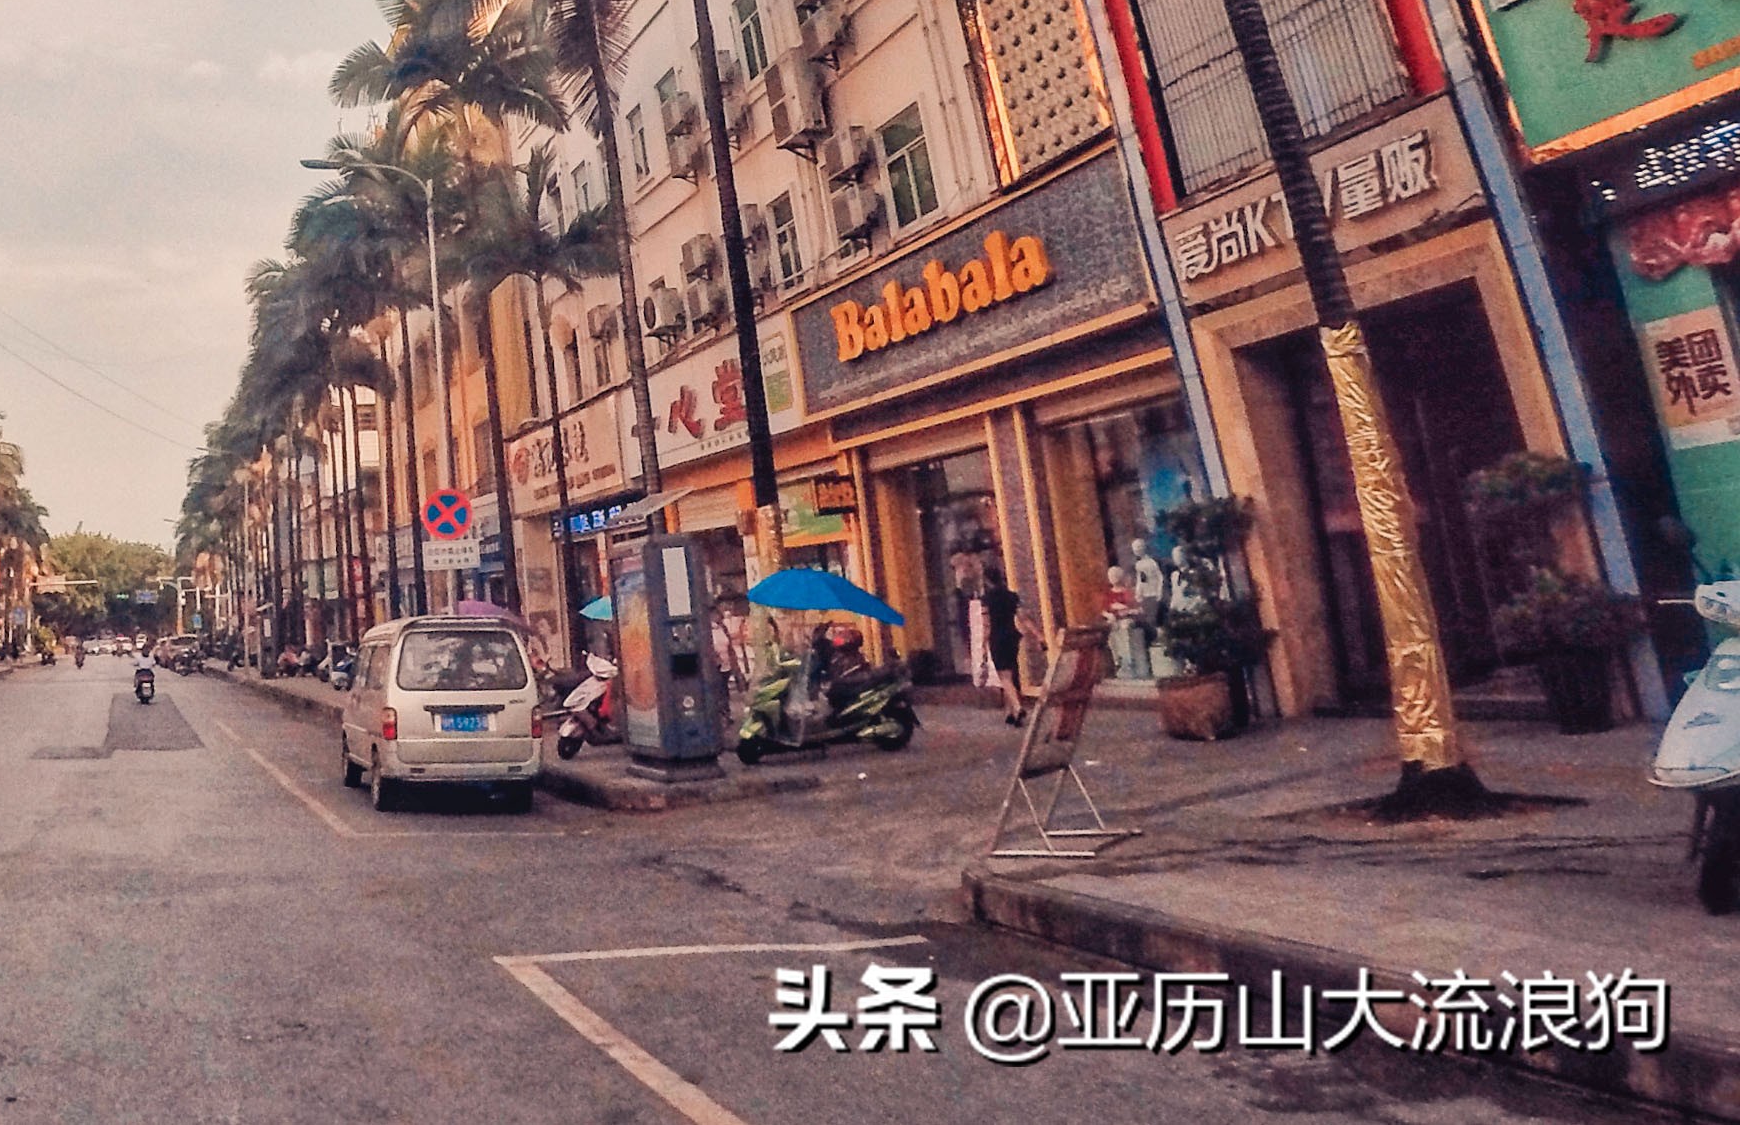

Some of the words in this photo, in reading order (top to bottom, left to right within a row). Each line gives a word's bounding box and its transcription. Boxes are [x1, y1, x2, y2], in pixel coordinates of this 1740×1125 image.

[829, 229, 1053, 363] Balabala
[1655, 328, 1723, 374] 美团
[1666, 363, 1732, 417] 外卖
